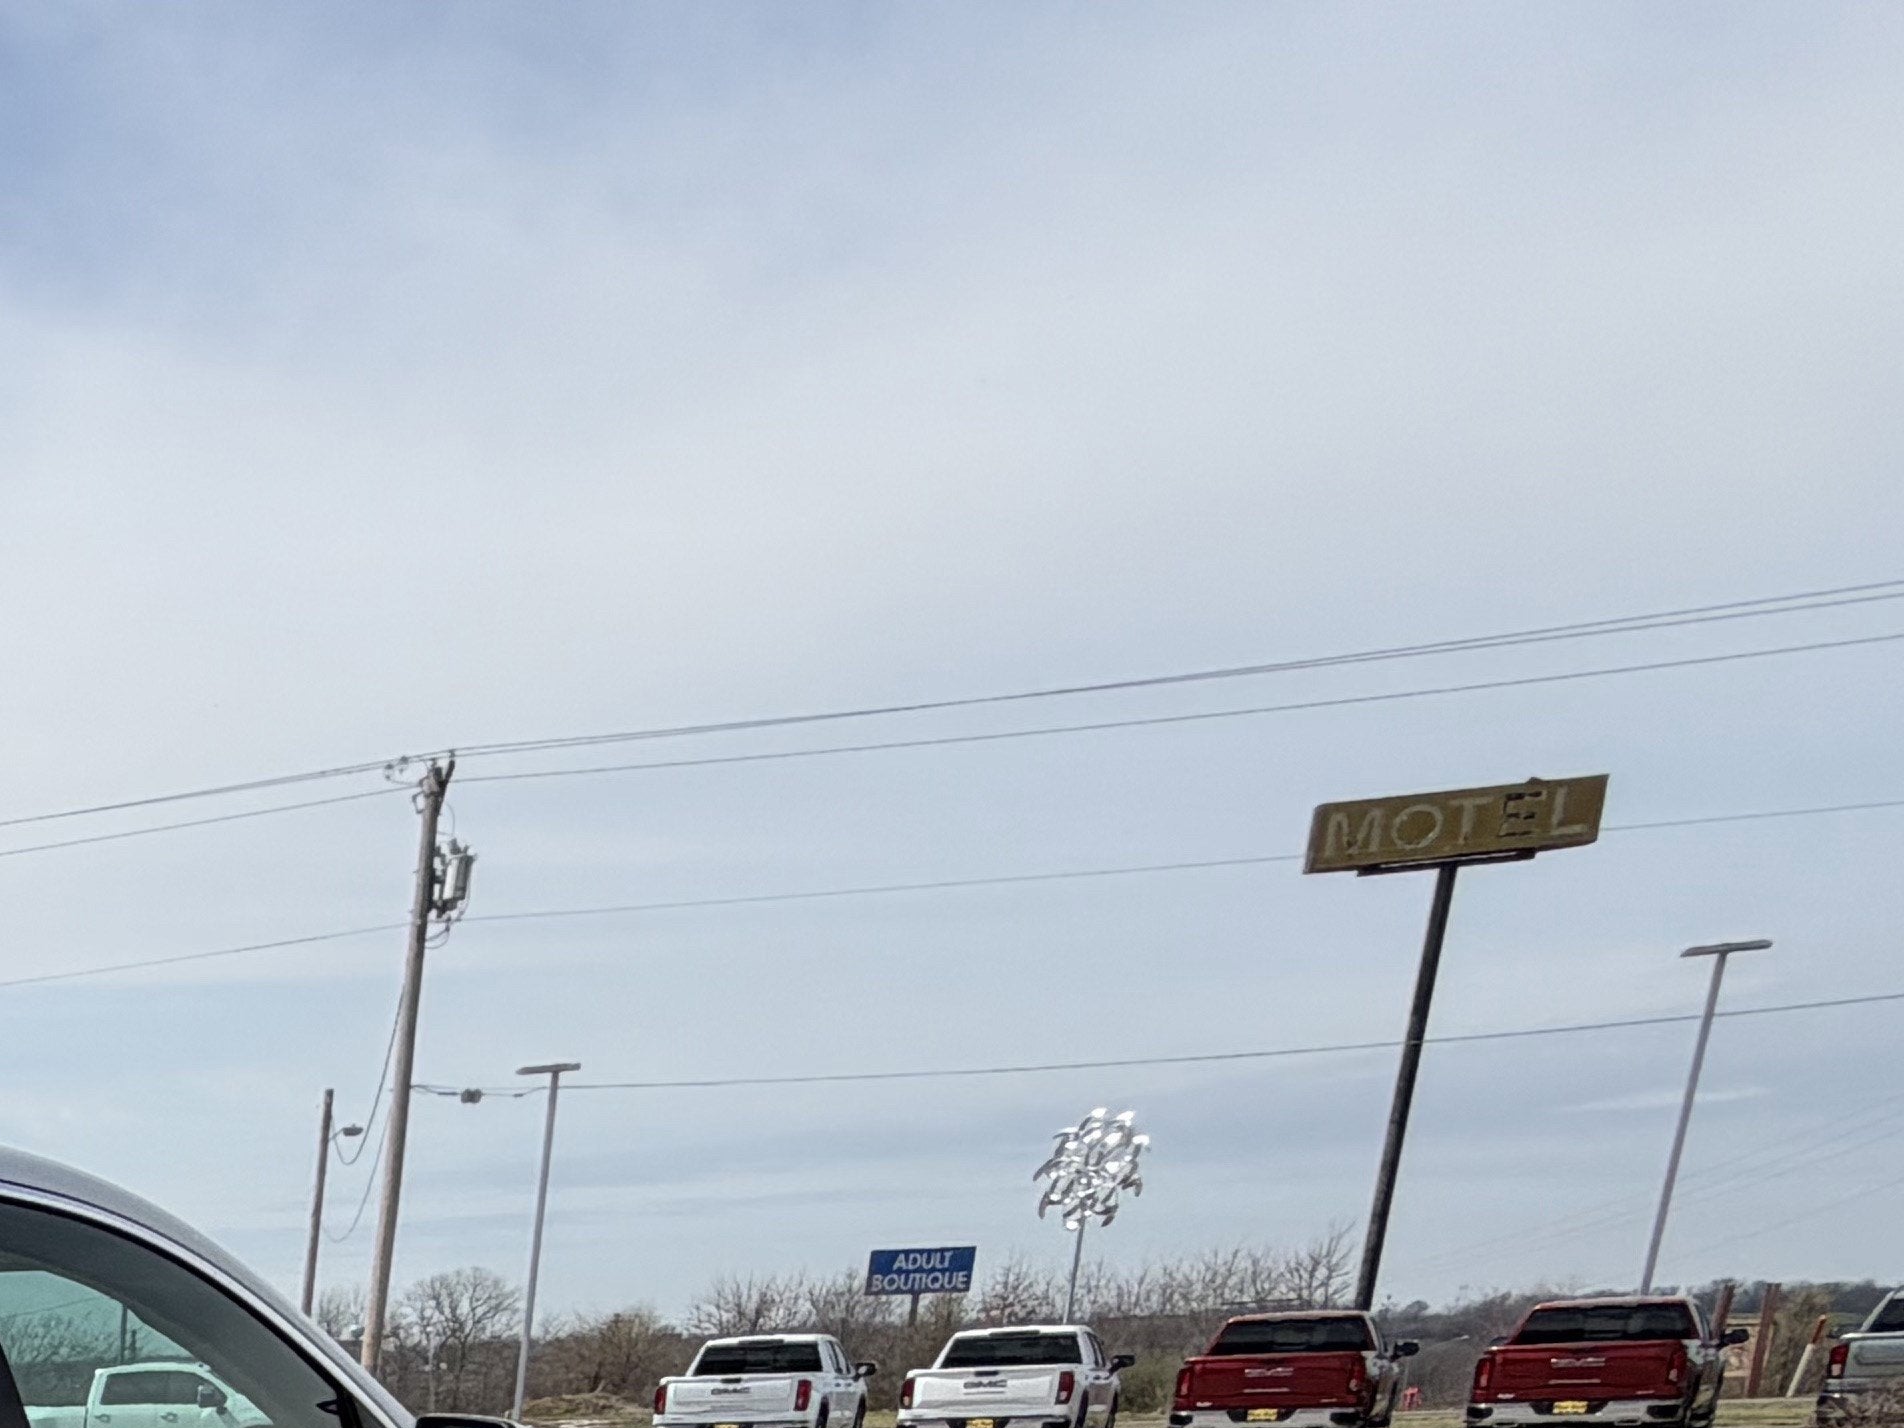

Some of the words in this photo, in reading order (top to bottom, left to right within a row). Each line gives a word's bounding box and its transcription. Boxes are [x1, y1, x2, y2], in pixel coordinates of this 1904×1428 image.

[1325, 787, 1587, 856] MOTEL
[893, 1252, 953, 1270] ADULT
[870, 1271, 968, 1292] BOUTIQUE
